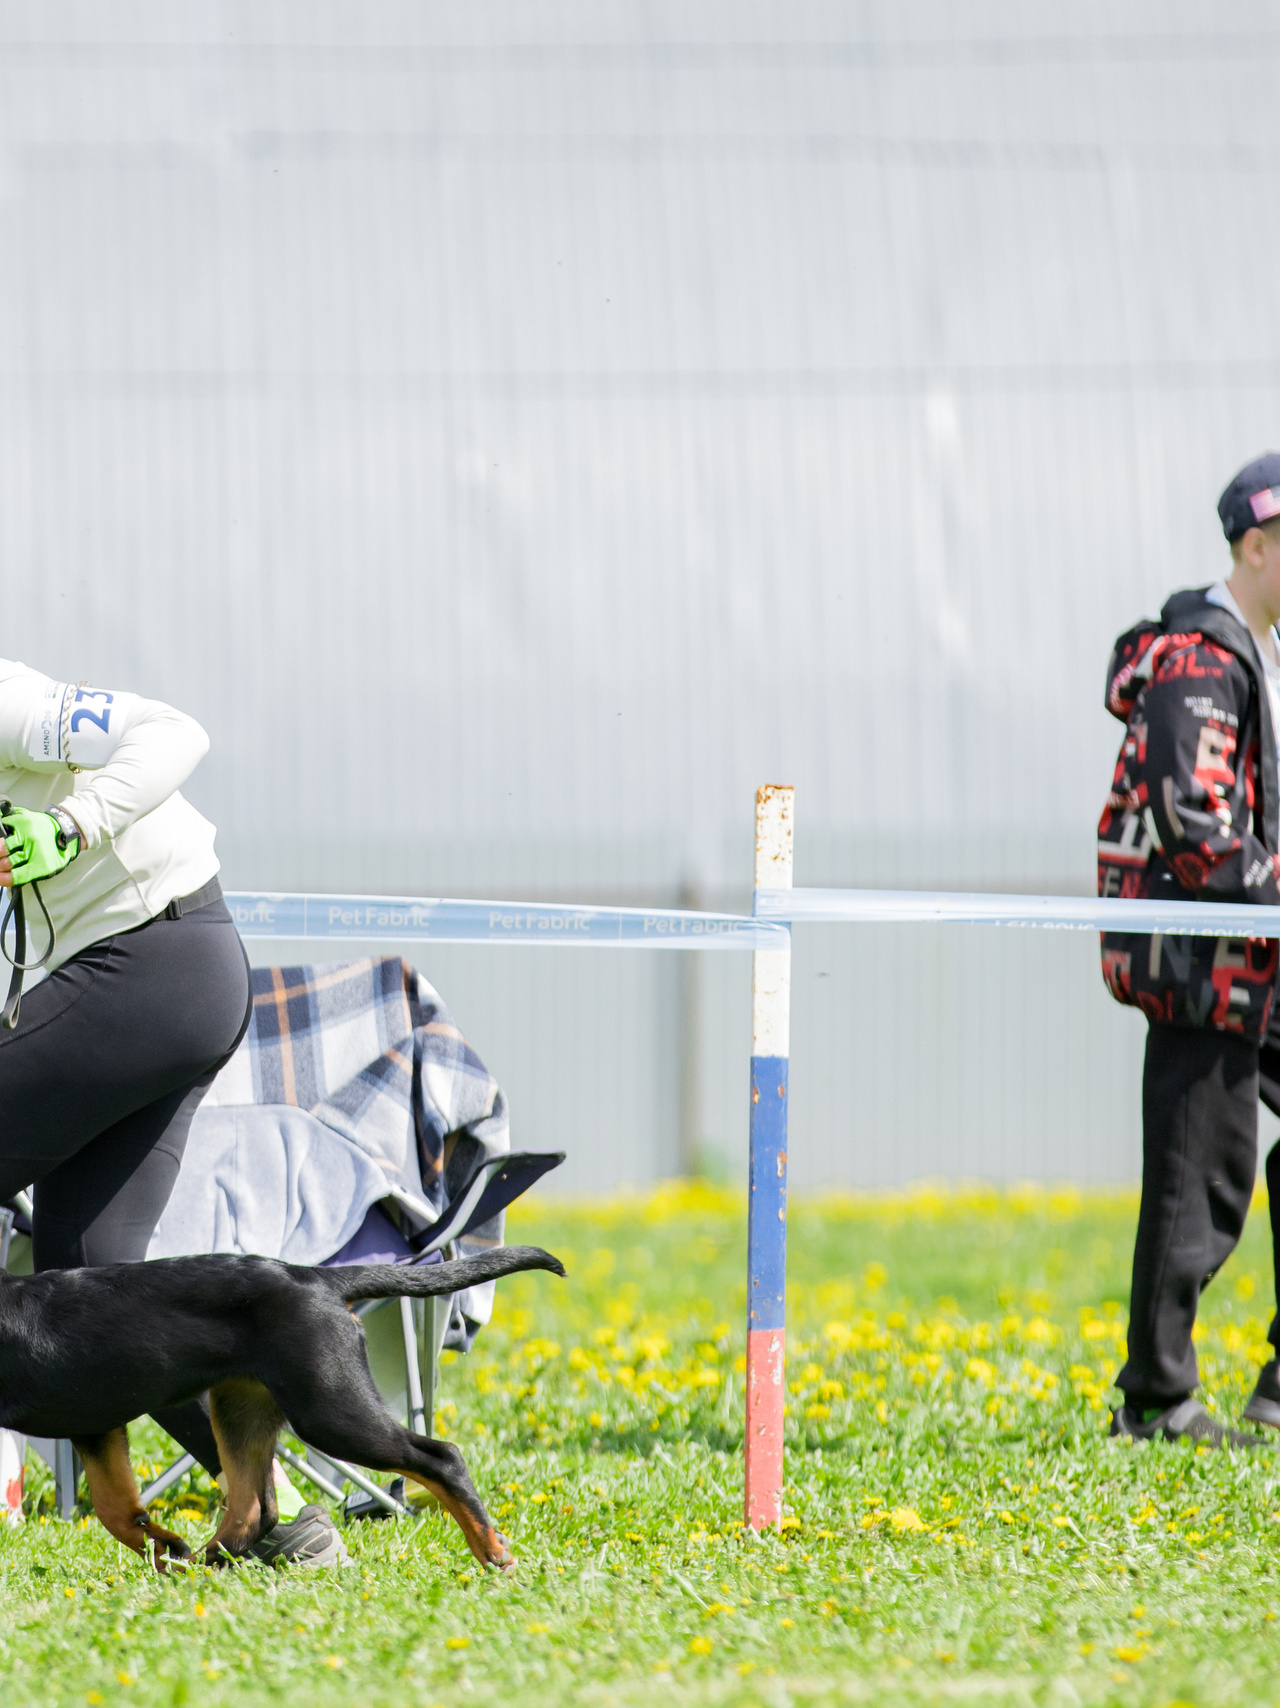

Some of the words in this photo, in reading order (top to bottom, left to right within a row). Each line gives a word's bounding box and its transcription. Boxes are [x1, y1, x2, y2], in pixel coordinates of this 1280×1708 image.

[71, 688, 114, 735] 23
[229, 901, 276, 924] bric
[328, 906, 362, 926] Pet
[365, 904, 430, 927] Fabric
[488, 911, 523, 929] Pet
[526, 911, 591, 931] Fabric
[643, 917, 677, 933] Pet
